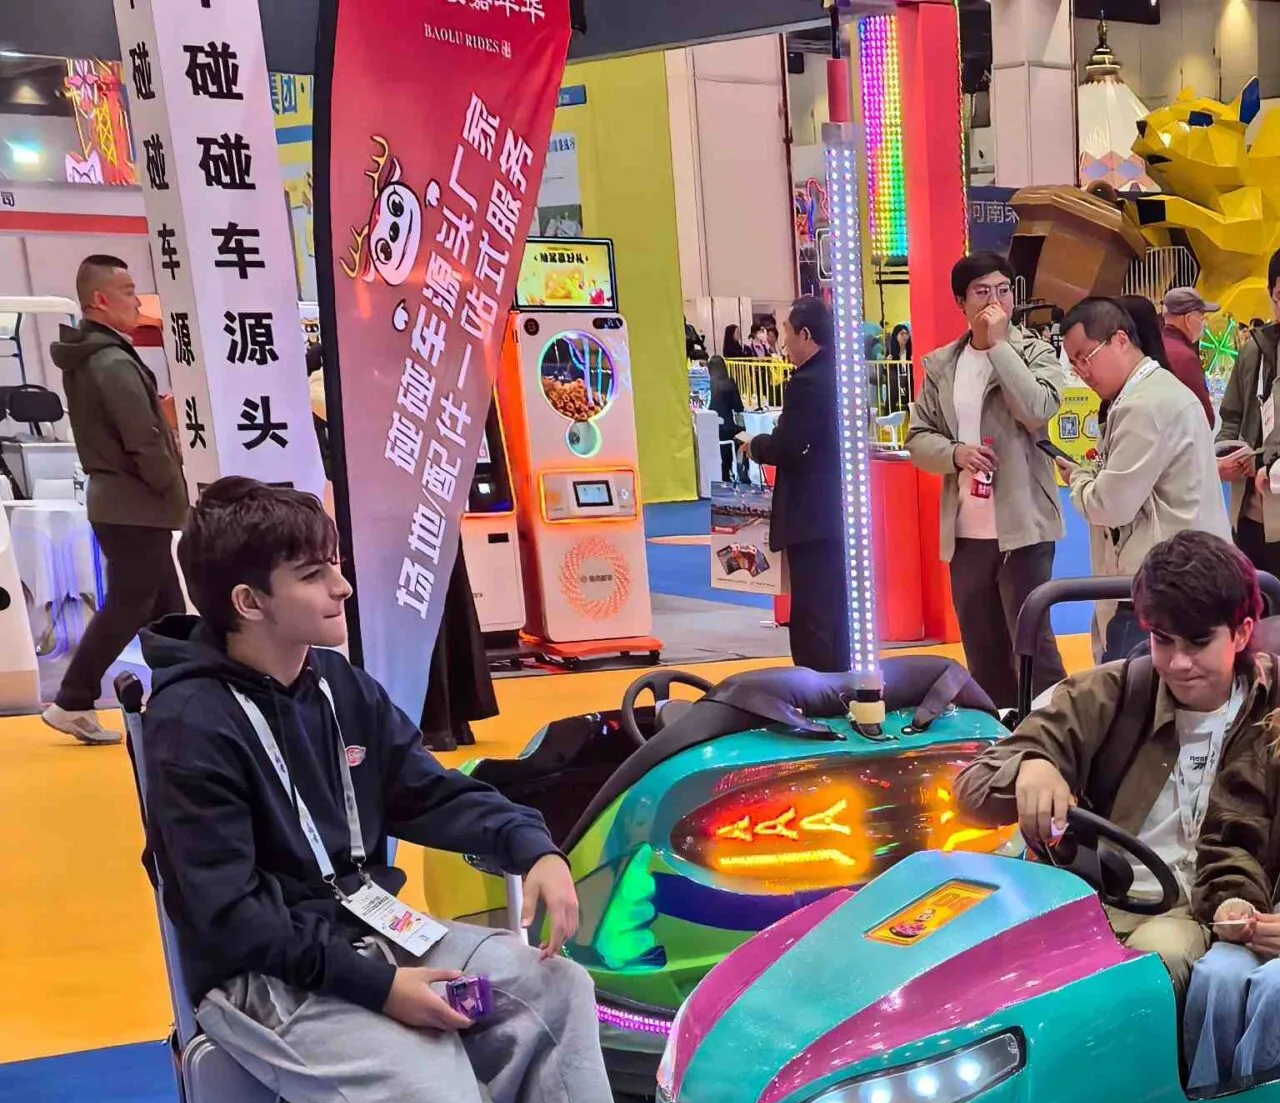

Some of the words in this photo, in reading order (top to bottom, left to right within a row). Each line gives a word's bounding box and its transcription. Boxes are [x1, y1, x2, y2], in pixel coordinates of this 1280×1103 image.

[129, 0, 215, 489] 碰碰车源头
[183, 0, 294, 489] 碰碰车源头
[424, 23, 464, 44] BAOLU
[465, 33, 500, 54] RIDES
[384, 91, 500, 476] 碰碰车源头厂家
[396, 127, 534, 620] 场地/配件一站式服务
